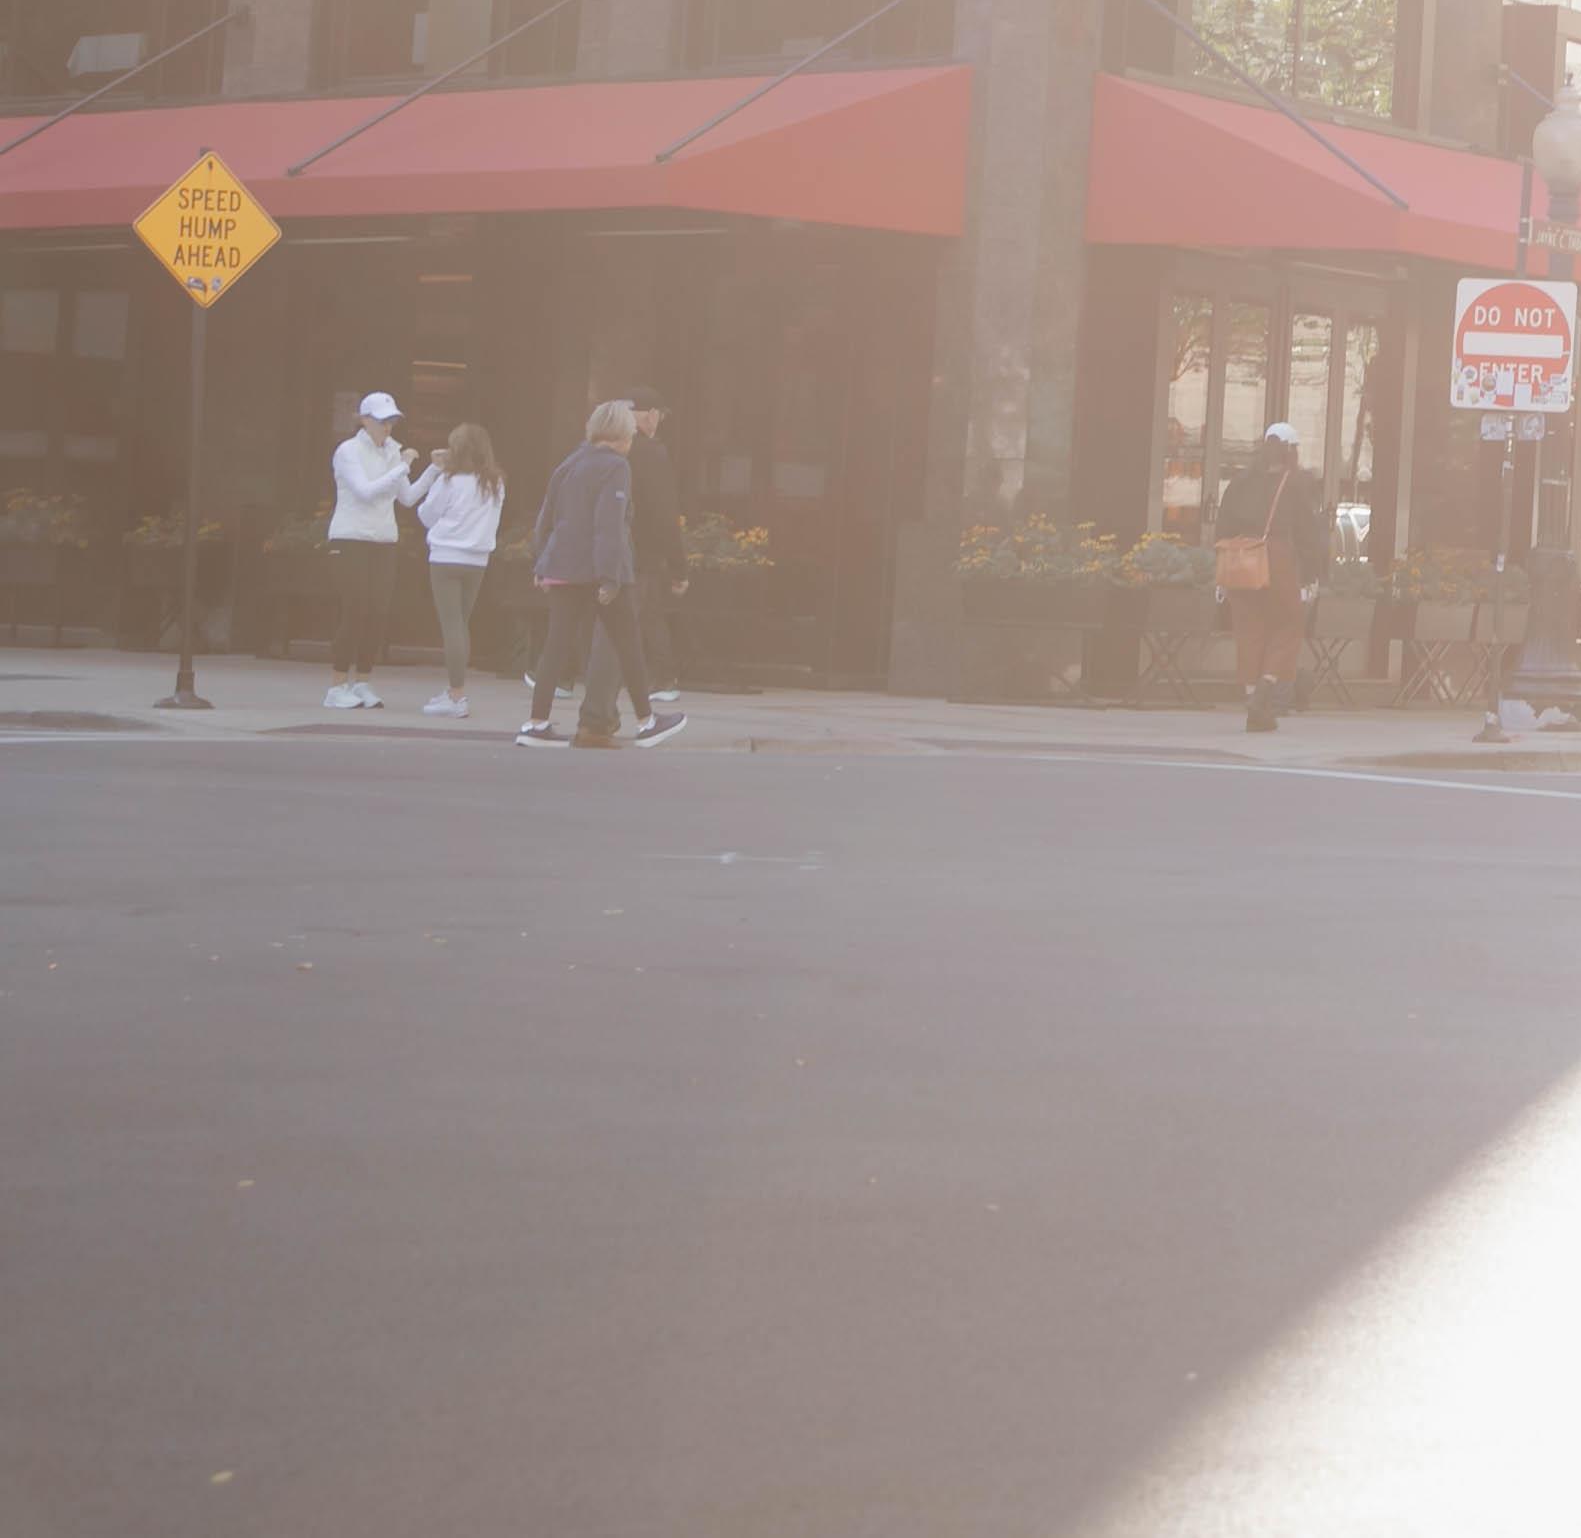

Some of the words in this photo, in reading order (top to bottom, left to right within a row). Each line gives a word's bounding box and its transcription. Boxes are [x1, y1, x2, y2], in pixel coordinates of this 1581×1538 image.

[178, 188, 242, 212] SPEED
[180, 217, 237, 239] HUMP
[173, 244, 242, 268] AHEAD
[1473, 305, 1502, 327] DO
[1514, 307, 1557, 328] NOT
